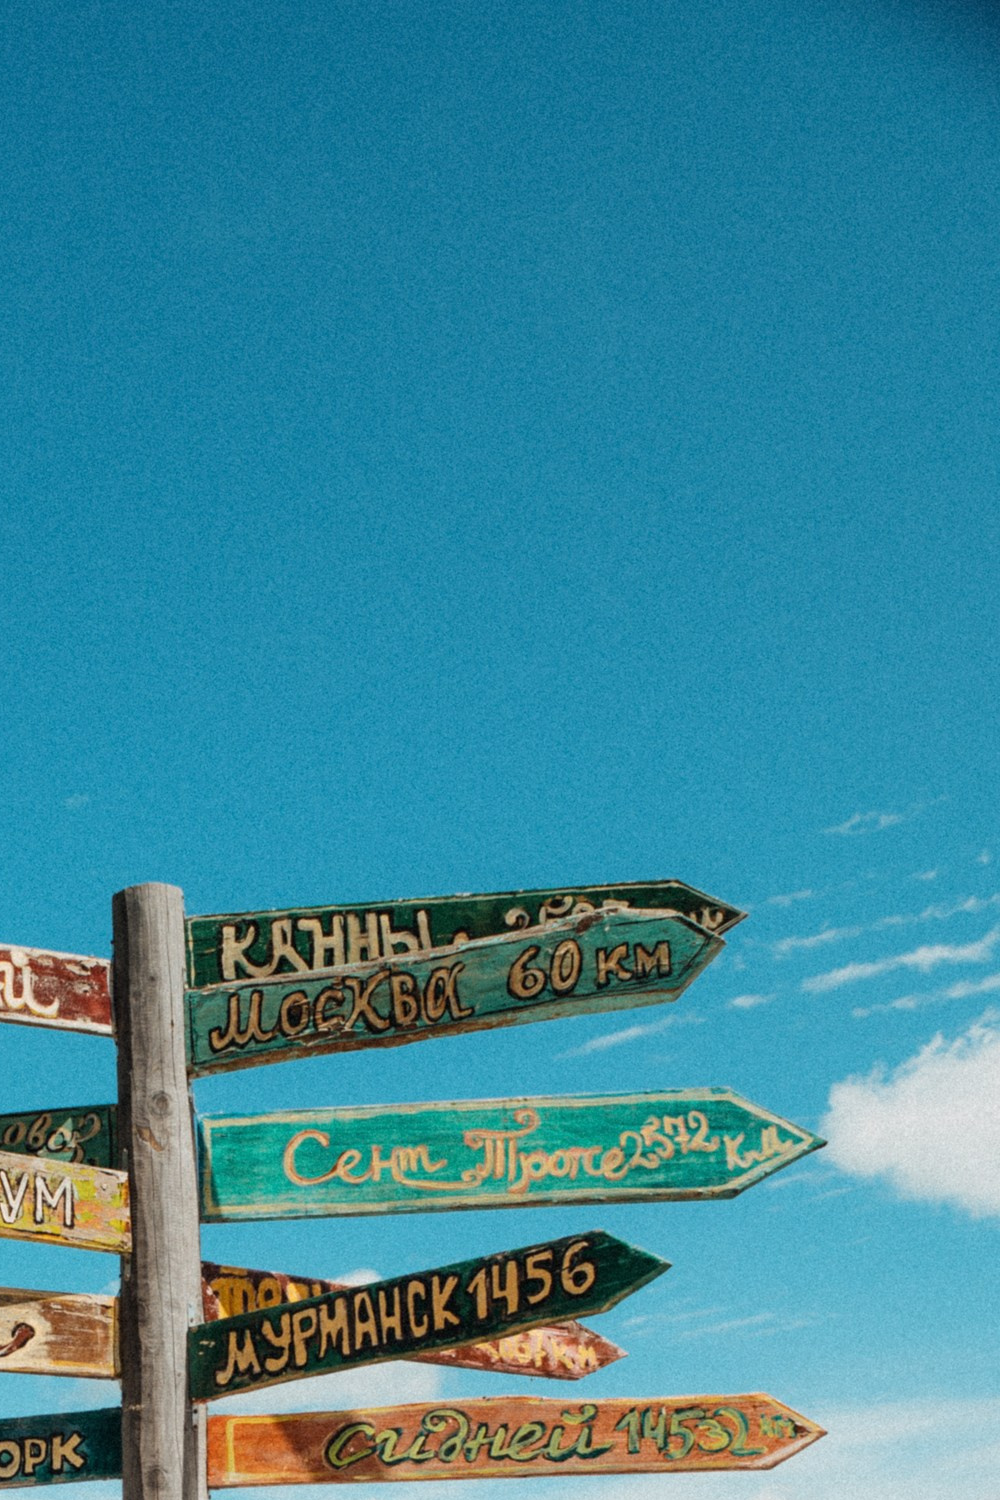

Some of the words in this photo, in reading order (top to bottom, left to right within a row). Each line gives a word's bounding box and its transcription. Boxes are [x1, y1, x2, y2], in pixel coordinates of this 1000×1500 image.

[507, 937, 583, 999] 60
[214, 1274, 460, 1386] МУРМАНСК
[465, 1239, 598, 1321] 1456
[616, 1405, 769, 1461] 14532
